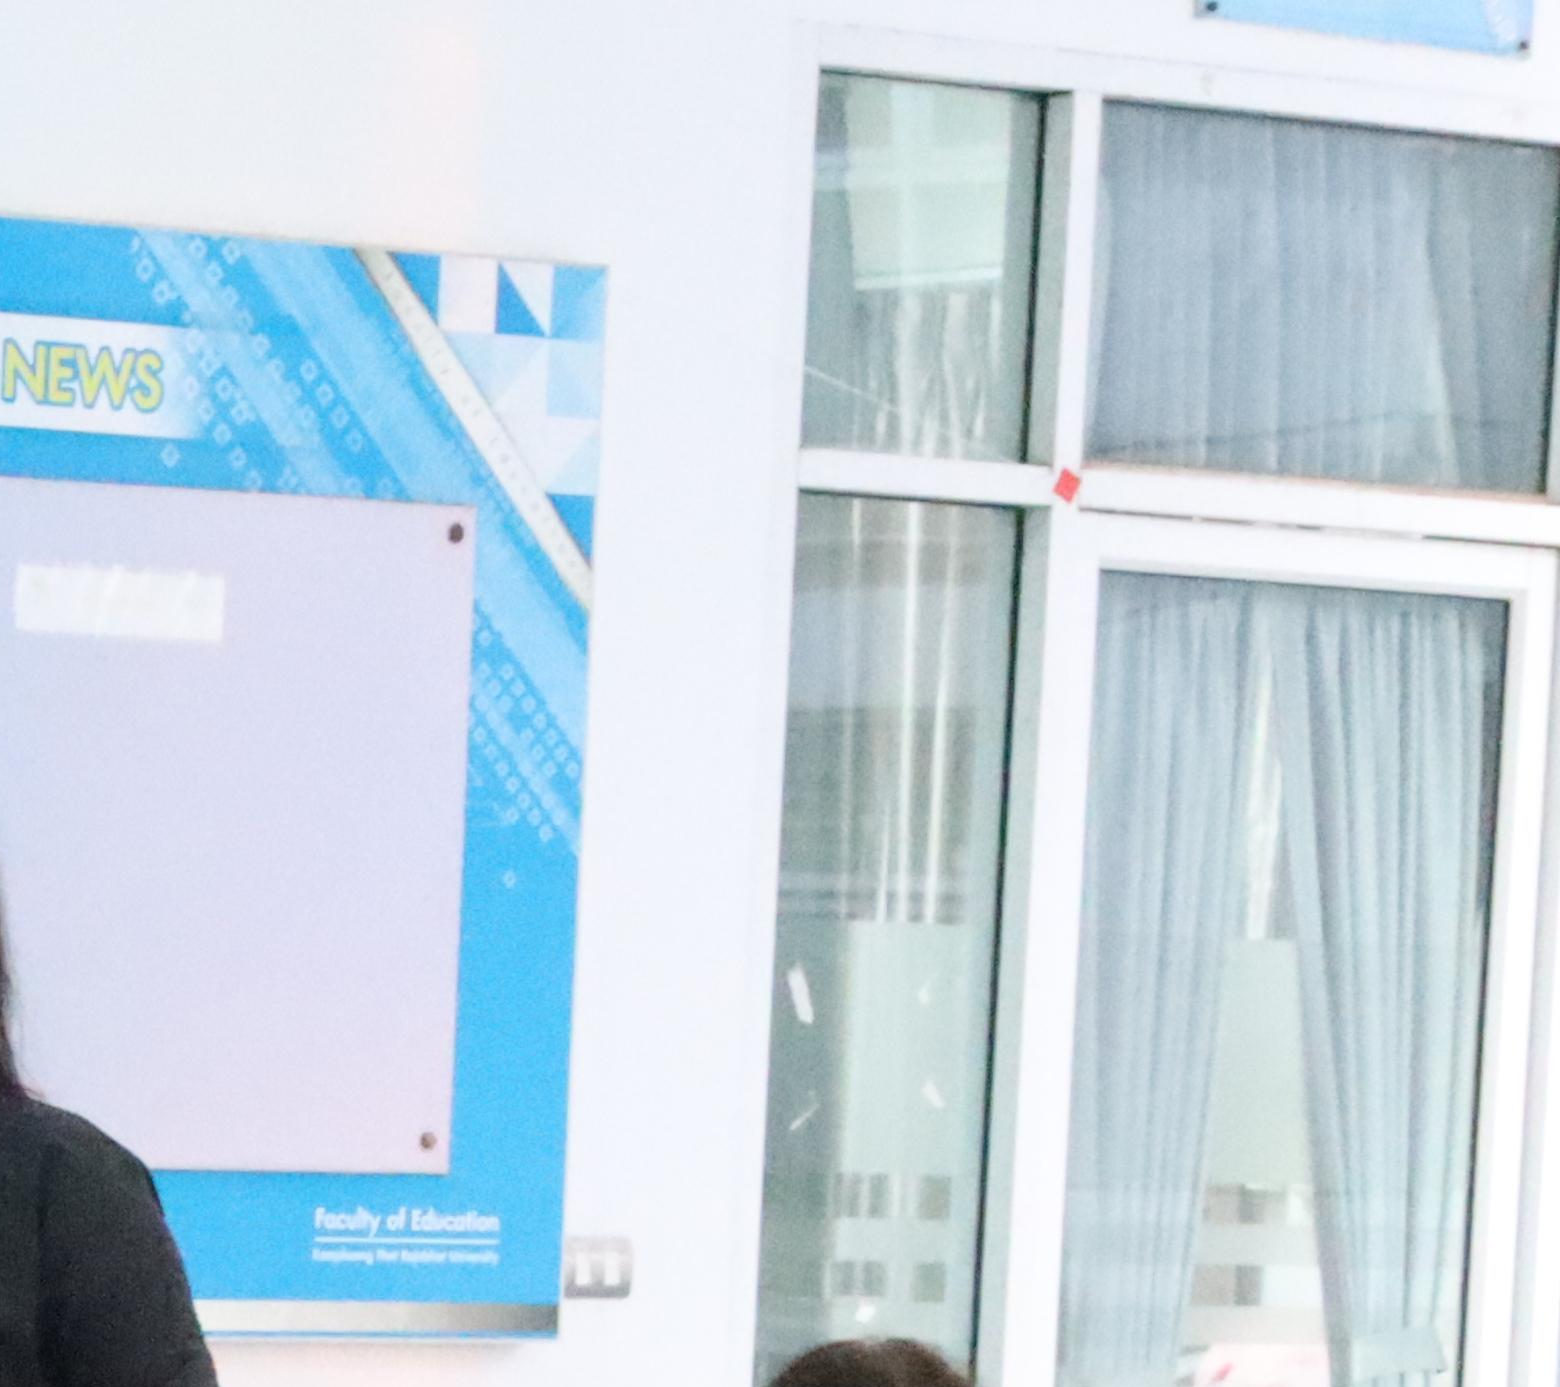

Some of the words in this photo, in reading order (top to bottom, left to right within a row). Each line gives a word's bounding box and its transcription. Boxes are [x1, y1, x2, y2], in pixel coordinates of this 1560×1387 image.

[1, 338, 166, 413] NEWS
[314, 1205, 381, 1238] Faculty
[386, 1205, 406, 1231] of
[410, 1205, 501, 1232] Education
